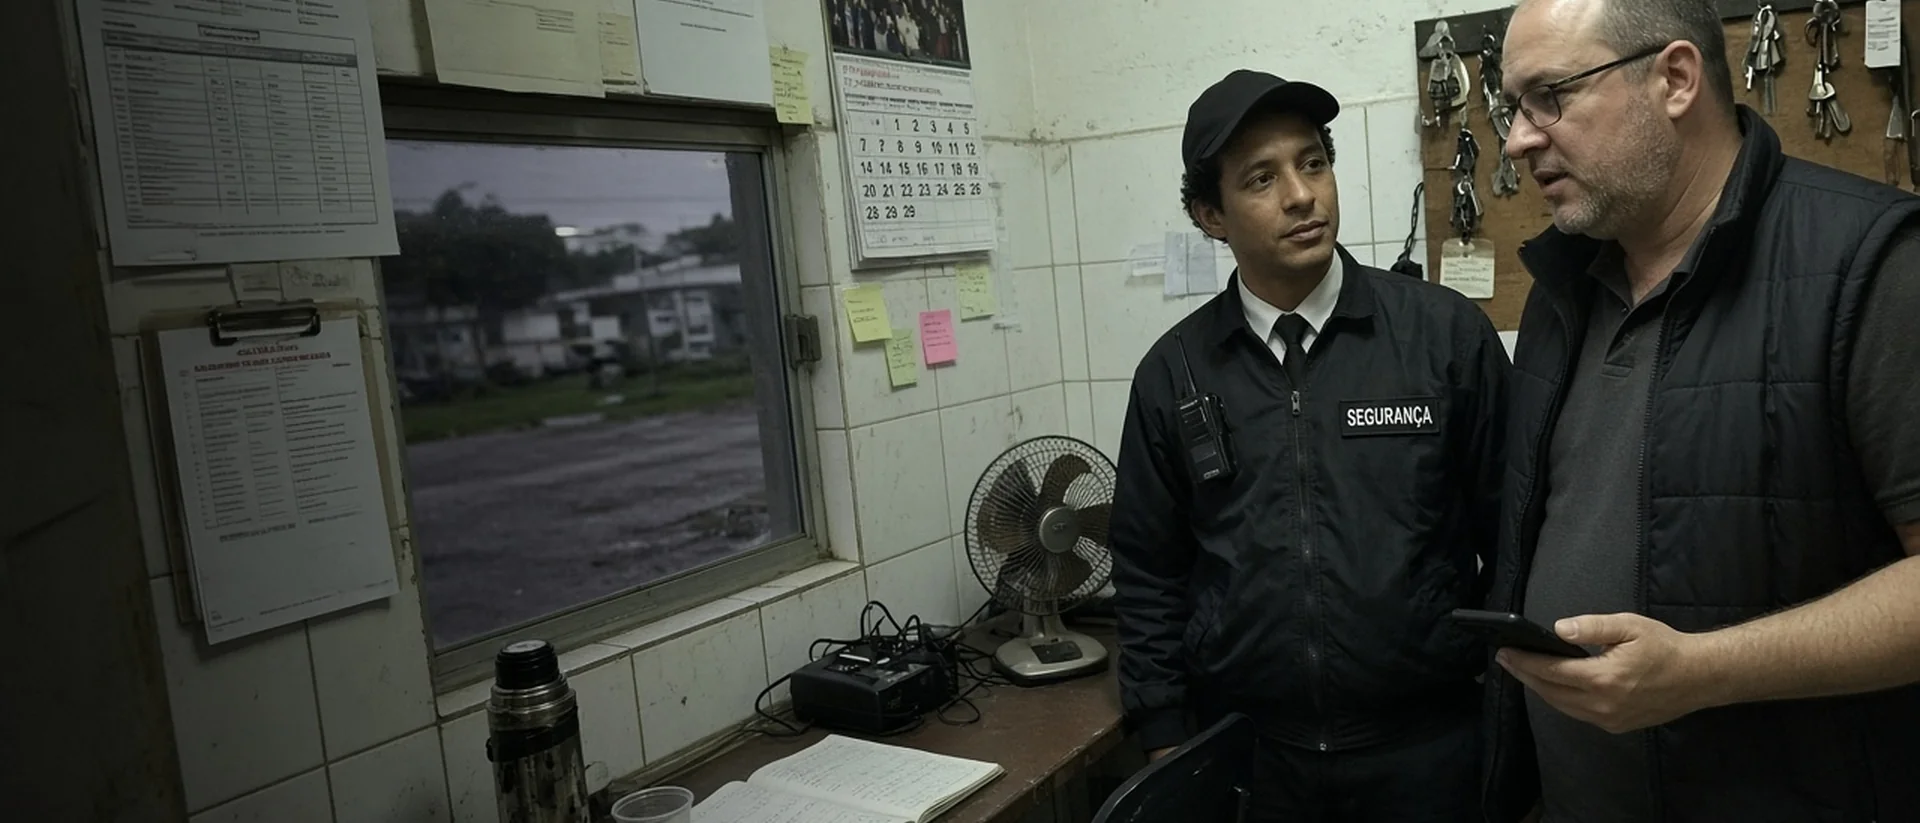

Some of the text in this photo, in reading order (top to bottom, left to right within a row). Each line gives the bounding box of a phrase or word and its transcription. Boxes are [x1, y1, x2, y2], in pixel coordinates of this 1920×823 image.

[895, 119, 899, 130] 1
[912, 119, 920, 132] 2
[930, 120, 937, 133] 3
[947, 122, 953, 134] 4
[860, 138, 866, 151] 7
[915, 140, 922, 153] 9
[932, 141, 942, 154] 10
[949, 142, 959, 155] 11
[966, 143, 976, 155] 12
[899, 162, 910, 175] 15
[917, 162, 928, 175] 16
[935, 163, 944, 175] 17
[952, 163, 962, 175] 18
[863, 184, 876, 198] 20
[883, 184, 894, 197] 21
[901, 184, 913, 197] 22
[918, 184, 930, 196] 23
[936, 184, 949, 196] 24
[1347, 406, 1433, 428] SEGURANÇA
